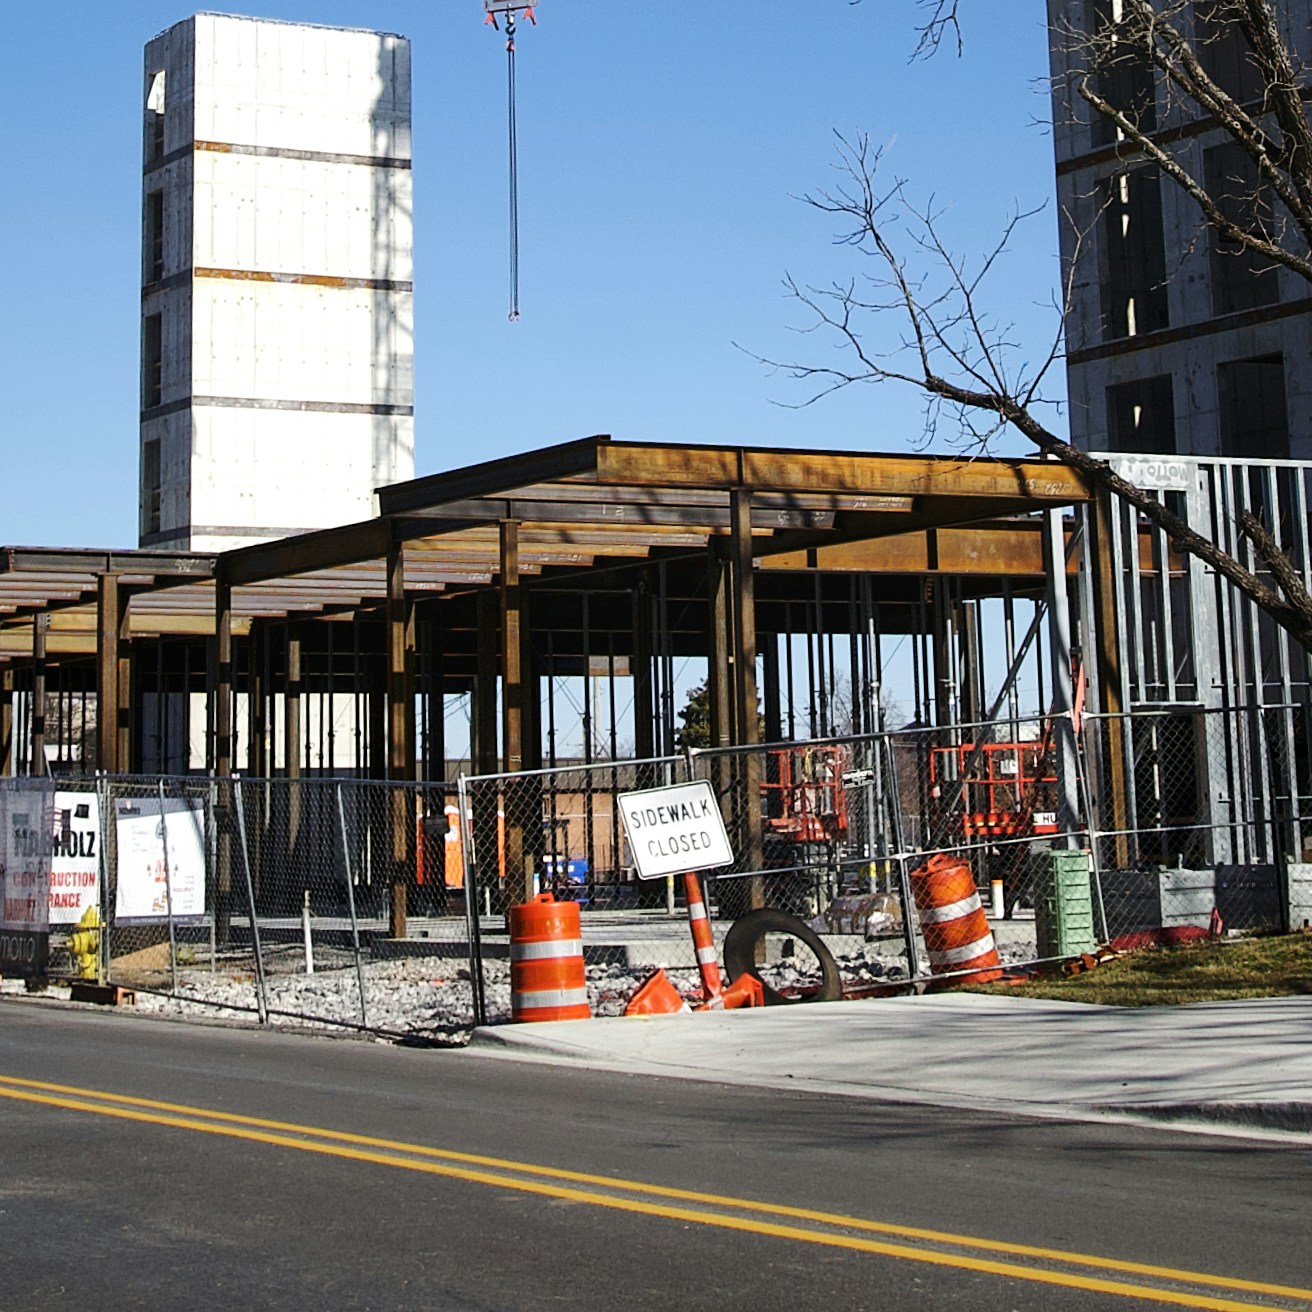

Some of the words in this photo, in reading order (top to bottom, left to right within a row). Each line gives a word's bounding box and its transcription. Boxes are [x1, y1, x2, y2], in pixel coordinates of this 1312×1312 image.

[631, 799, 712, 829] SIDEWALK
[648, 831, 711, 858] CLOSED
[13, 872, 95, 887] CONTRUCTION
